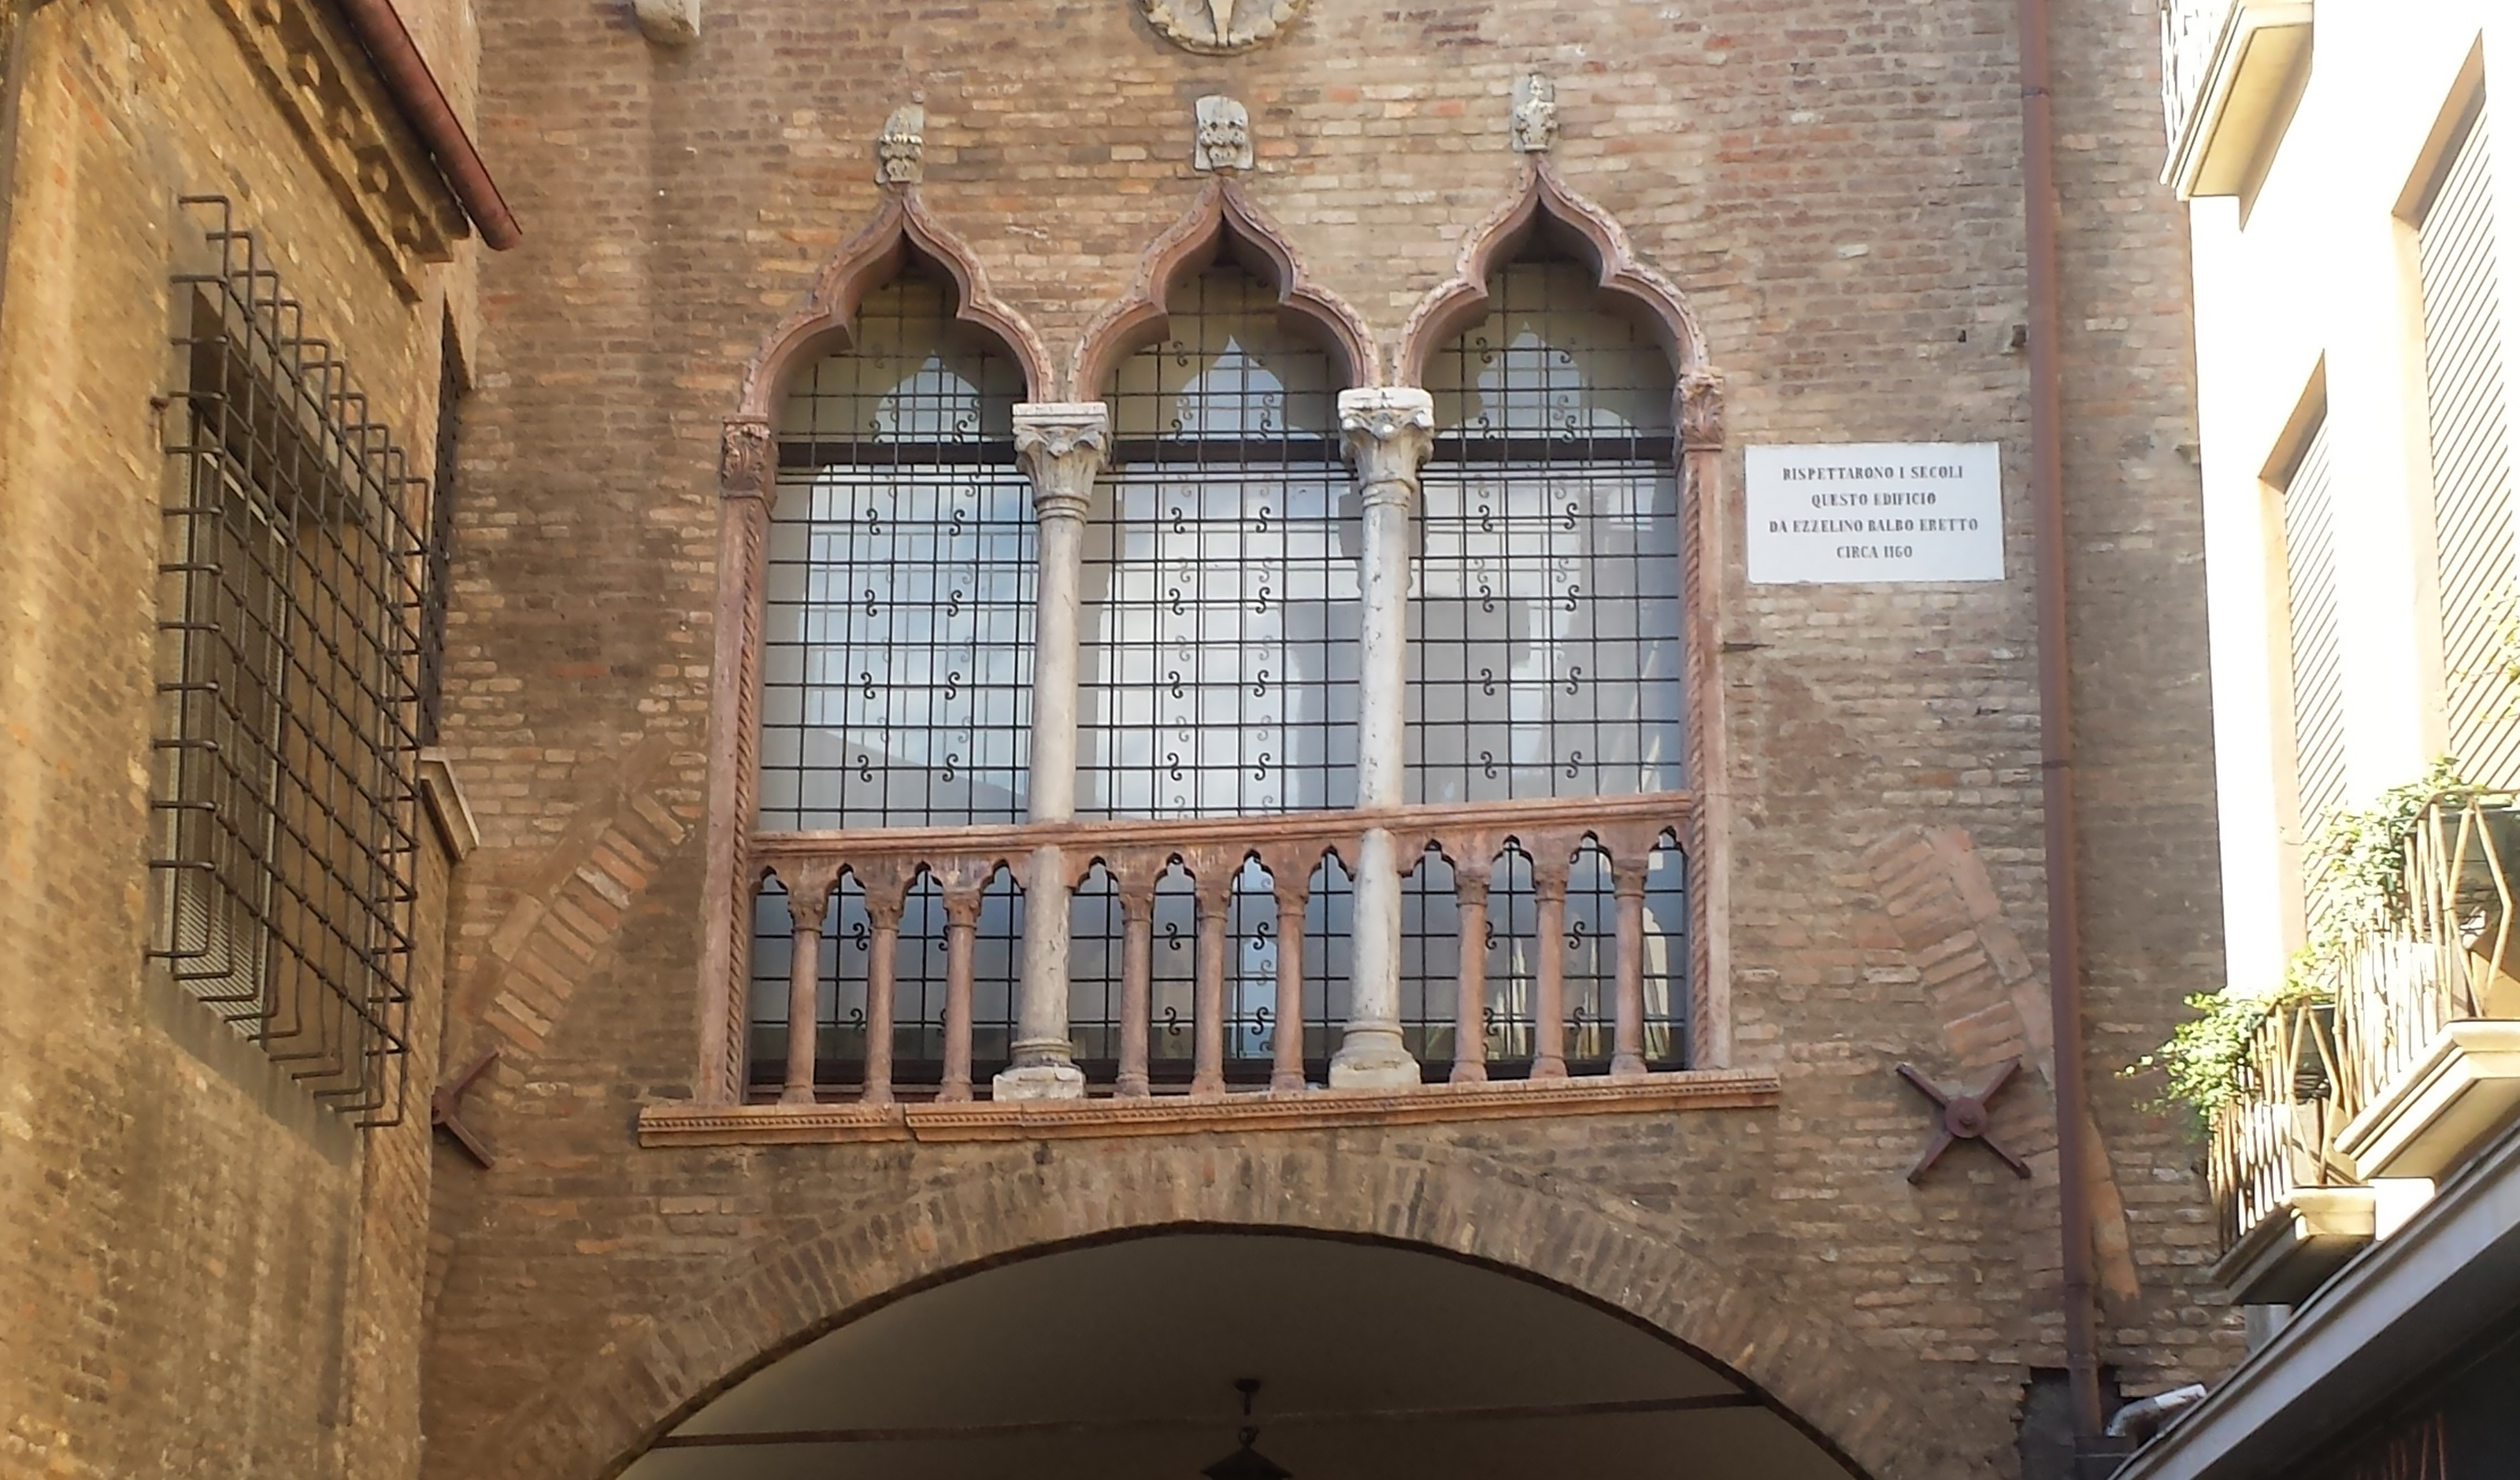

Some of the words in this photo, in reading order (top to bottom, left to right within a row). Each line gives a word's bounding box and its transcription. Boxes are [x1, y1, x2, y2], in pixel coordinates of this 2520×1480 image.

[1783, 467, 1894, 481] RISPETTARONO
[1899, 466, 1905, 479] I
[1910, 465, 1963, 479] SECOLI
[1811, 493, 1868, 509] QUESTO
[1874, 492, 1936, 506] EDIFICIO
[1770, 520, 1788, 533] DA
[1793, 519, 1863, 533] EZZELINO
[1868, 519, 1914, 532] BALBO
[1920, 518, 1978, 531] ERETTO
[1836, 546, 1878, 559] CIRCA
